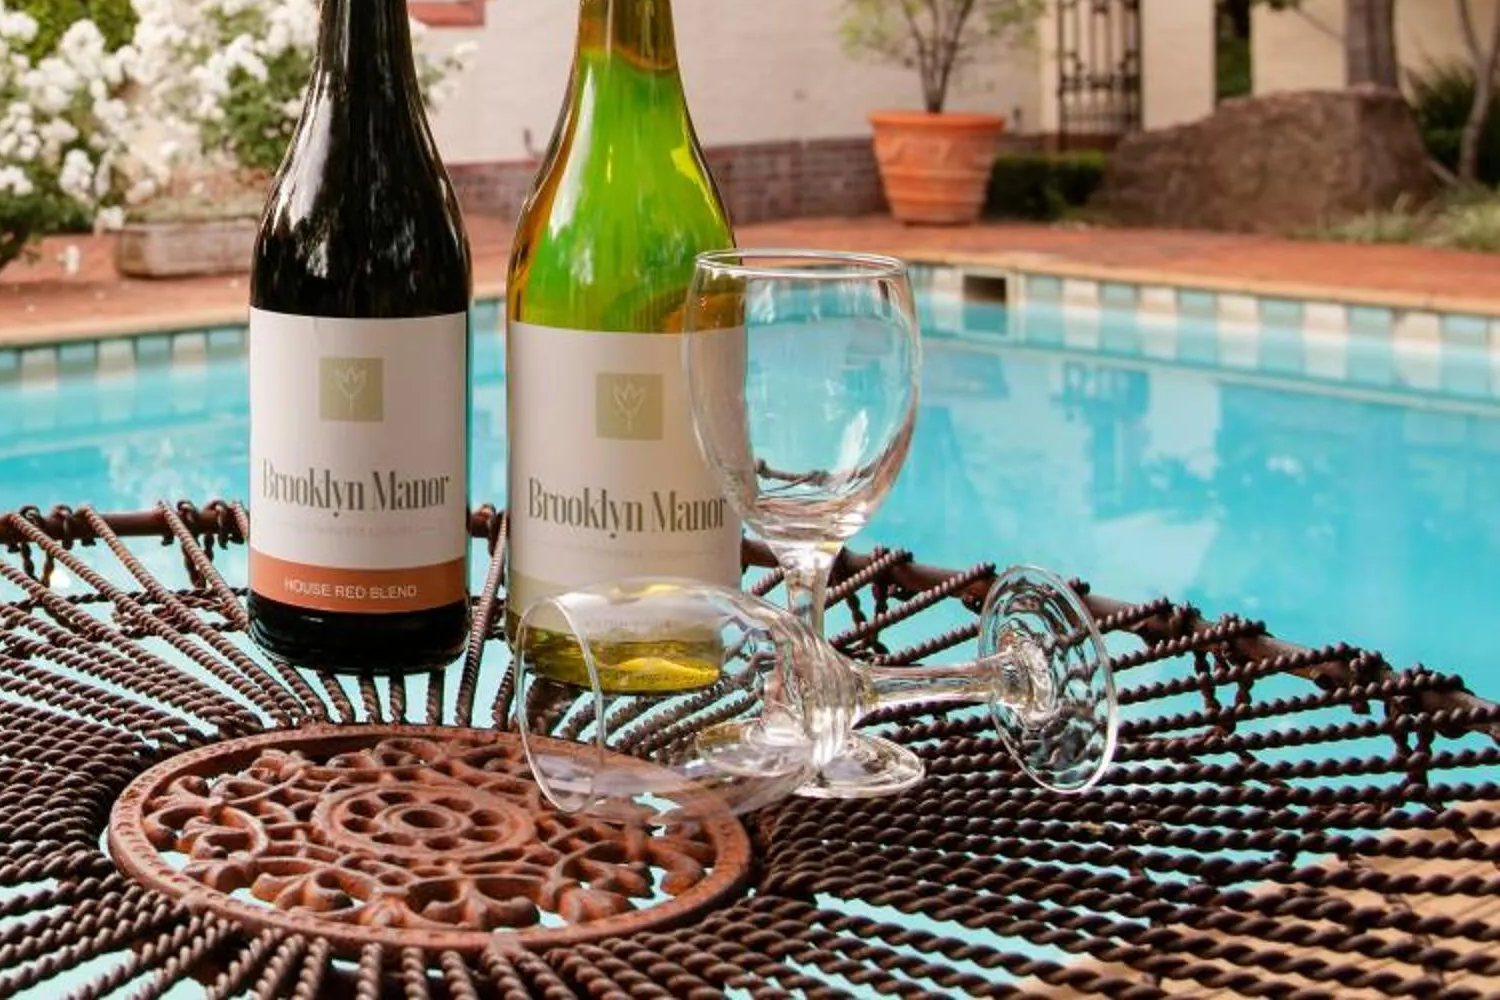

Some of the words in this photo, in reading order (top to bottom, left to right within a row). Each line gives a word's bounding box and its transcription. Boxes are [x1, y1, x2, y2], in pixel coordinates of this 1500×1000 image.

[262, 458, 365, 518] Brooklyn
[370, 470, 450, 512] Manor
[528, 476, 644, 540] Brooklyn
[651, 489, 728, 534] Manor
[283, 576, 333, 597] HOUSE
[334, 584, 367, 600] RED
[369, 583, 418, 600] BLEND
